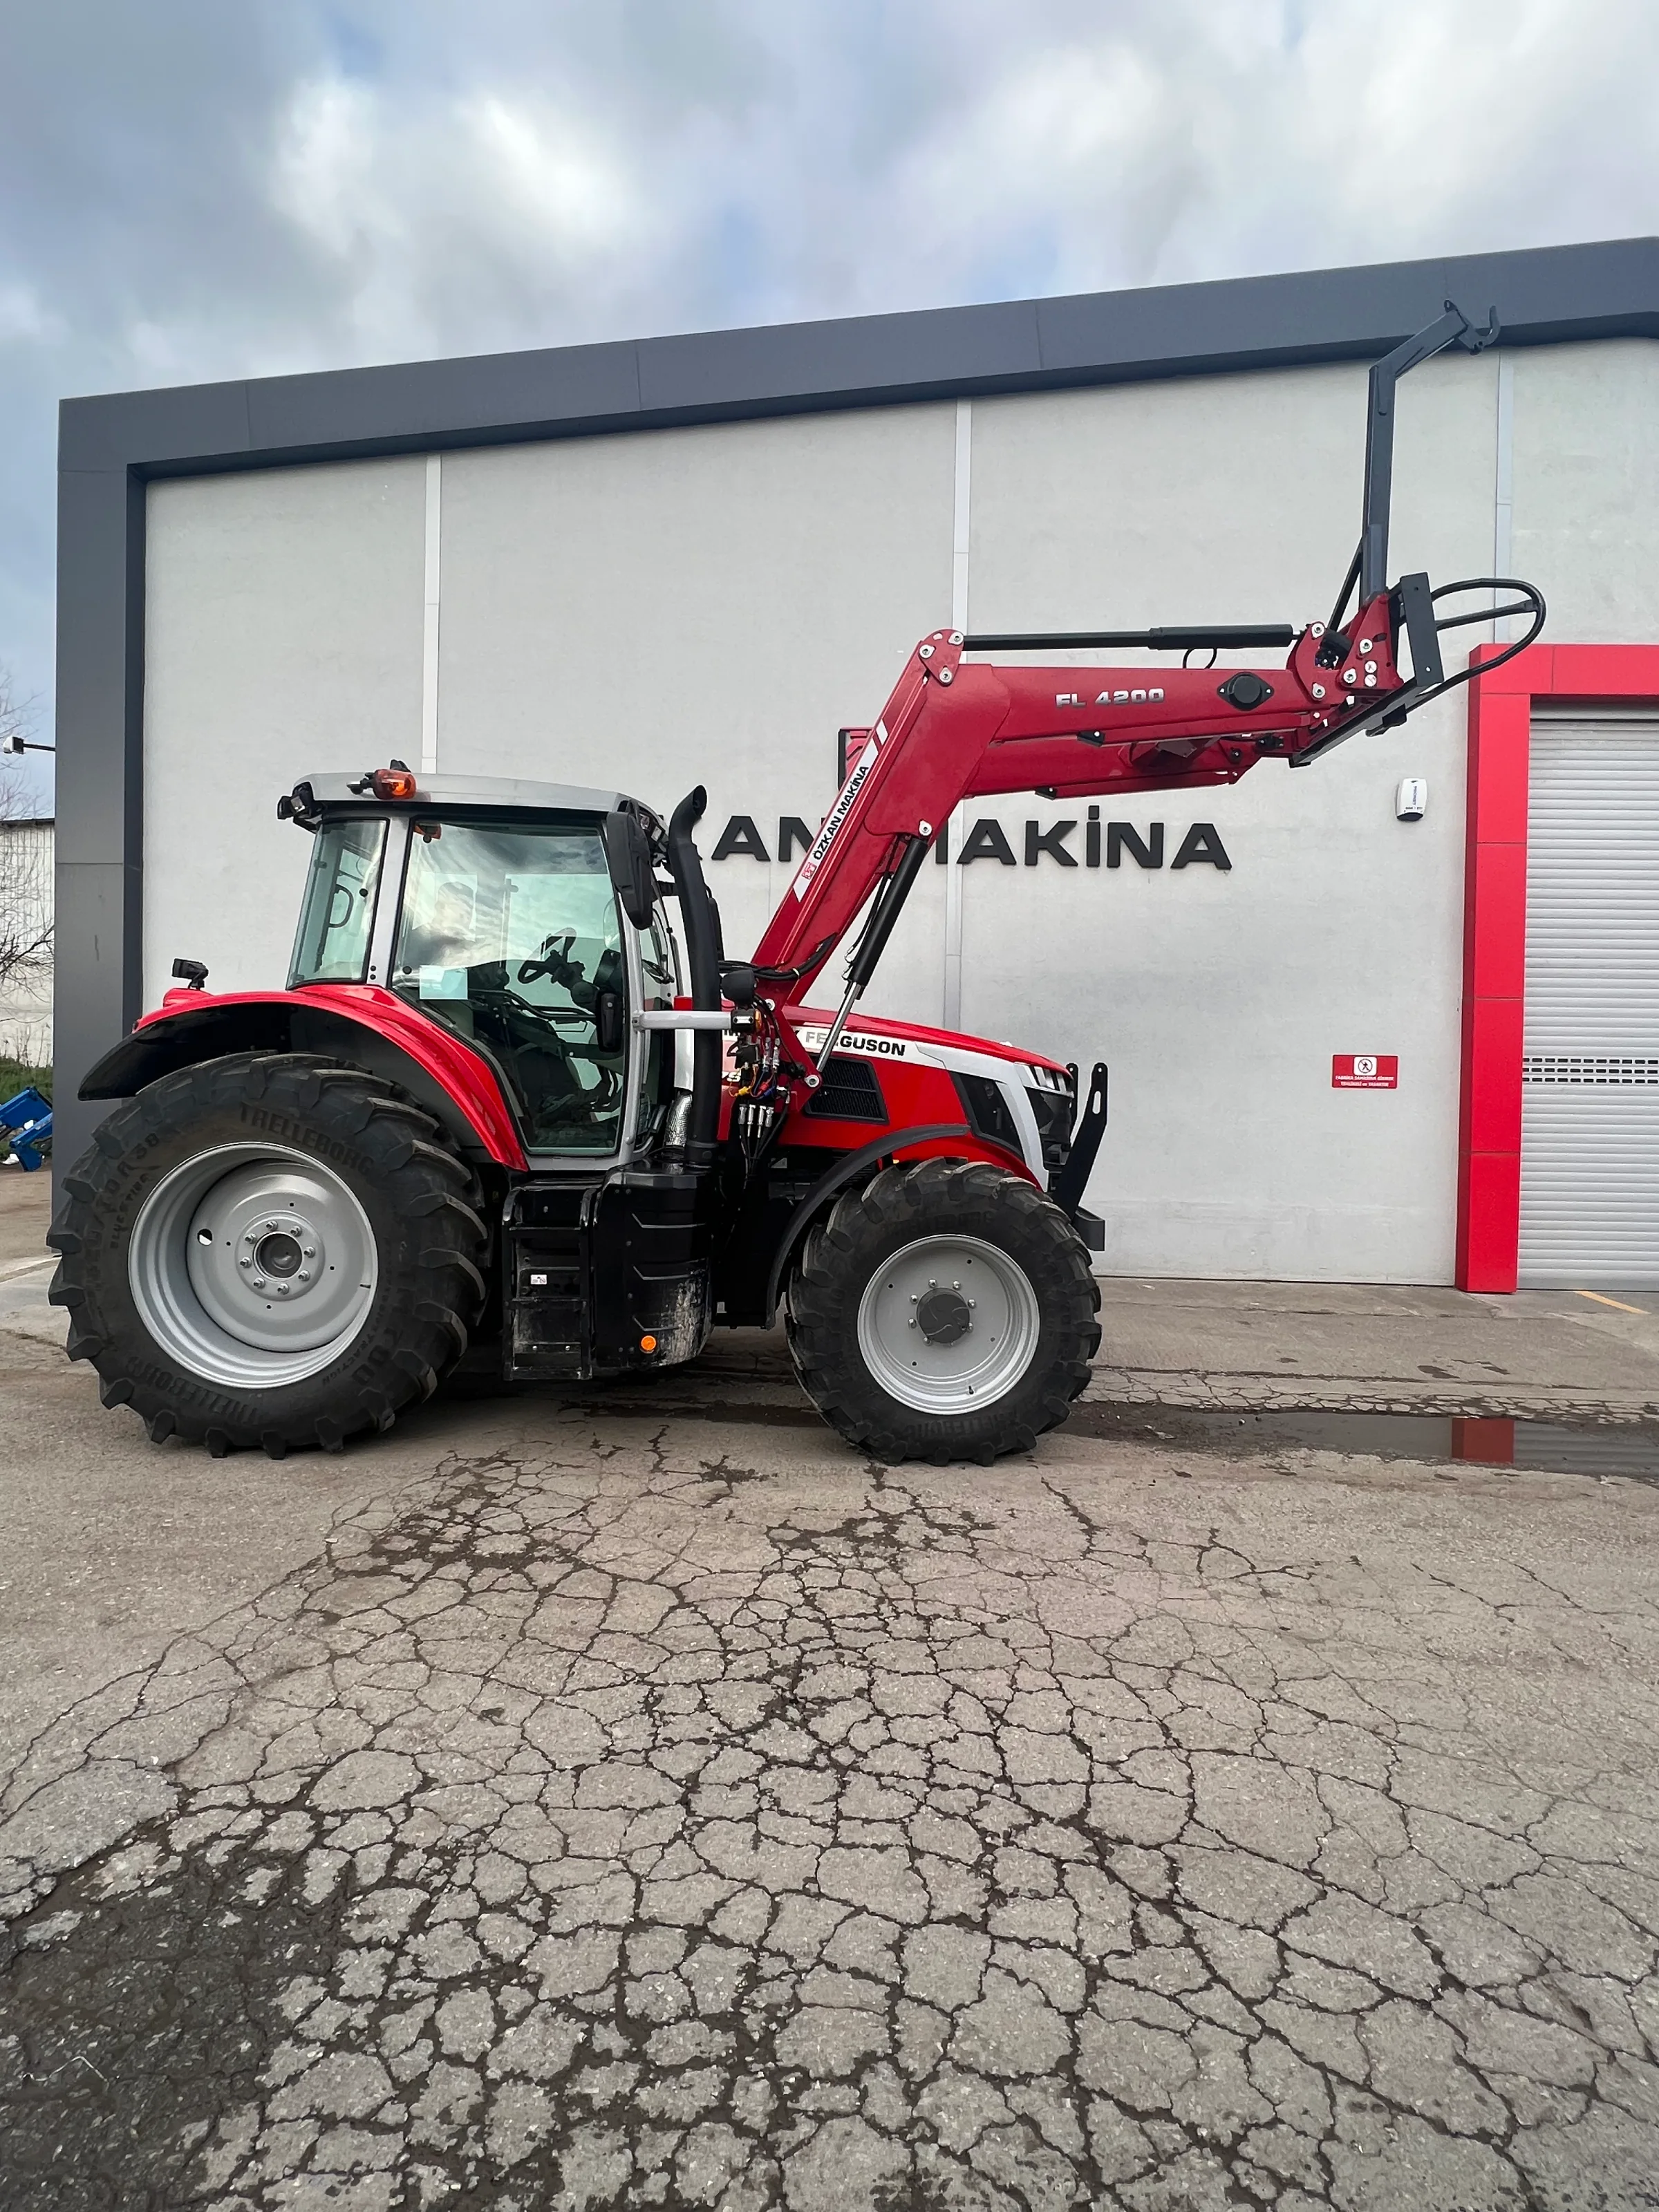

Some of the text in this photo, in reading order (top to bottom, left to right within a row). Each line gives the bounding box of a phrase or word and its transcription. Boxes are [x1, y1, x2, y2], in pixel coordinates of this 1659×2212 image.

[1056, 687, 1165, 709] FL 4200
[812, 765, 870, 861] ÖZKAN MAKİNA
[805, 1031, 906, 1057] FEGUSON
[240, 1102, 374, 1176] TRELLEBORG
